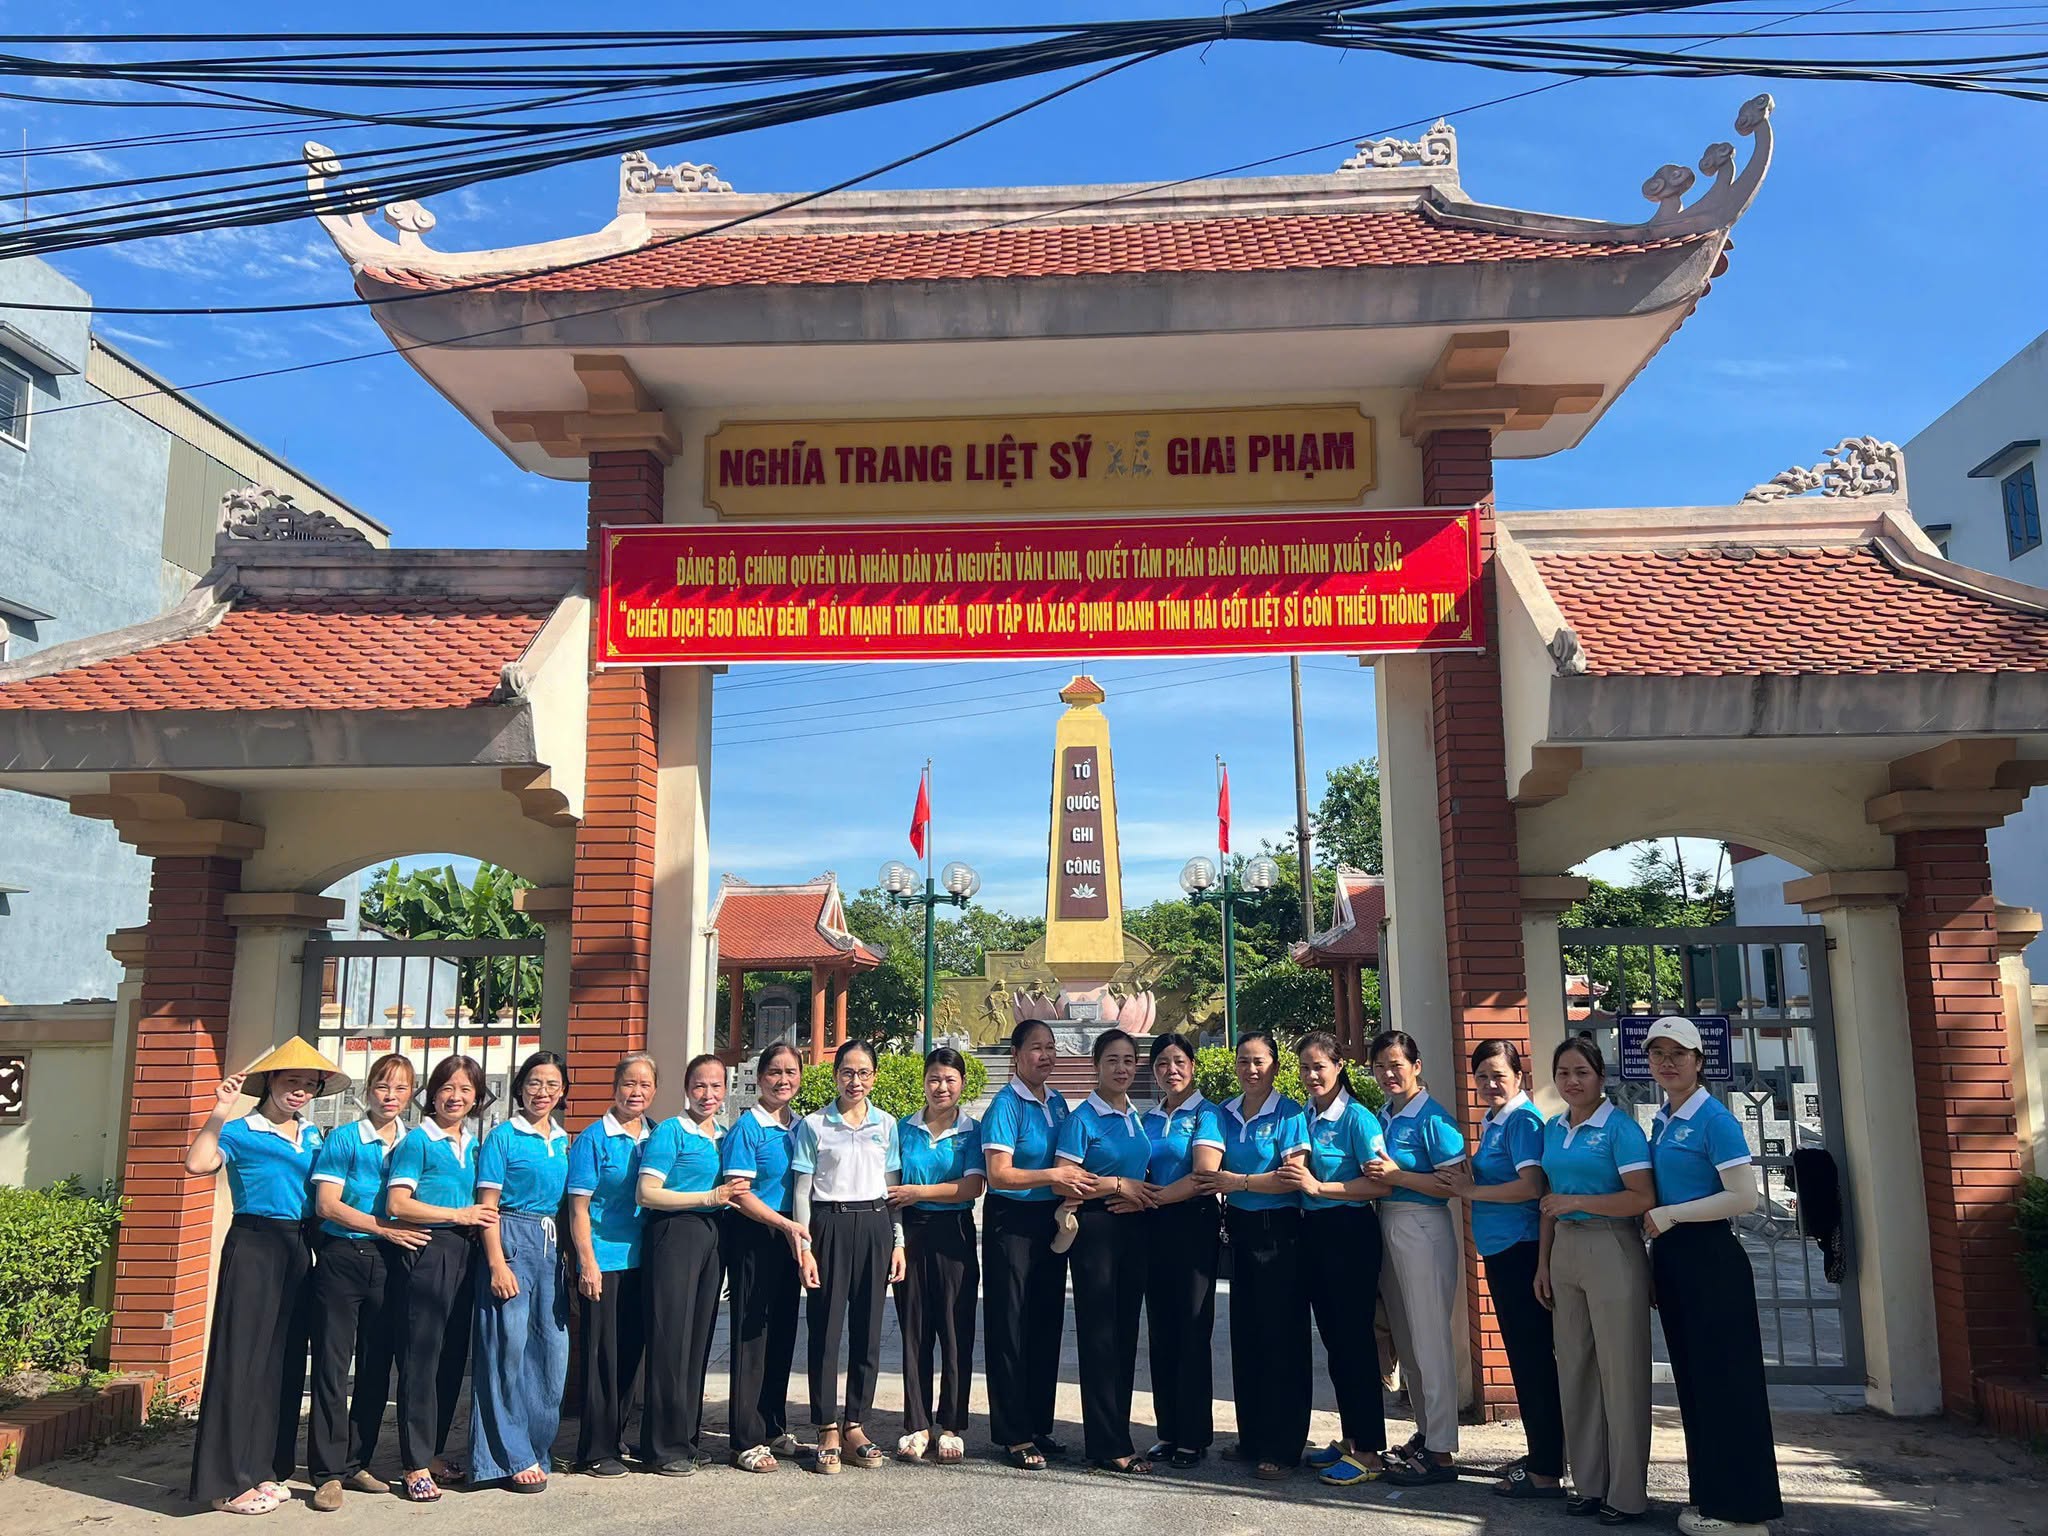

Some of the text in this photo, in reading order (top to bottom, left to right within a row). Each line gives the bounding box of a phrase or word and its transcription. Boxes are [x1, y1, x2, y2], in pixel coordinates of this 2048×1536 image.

[720, 440, 825, 486] NGHĨA
[835, 444, 952, 483] TRANG
[966, 433, 1038, 488] LIỆT
[1049, 433, 1092, 480] SỸ
[1167, 436, 1236, 475] GIAI
[1248, 431, 1355, 479] PHẠM
[676, 530, 1403, 591] ĐẢNG BỘ, CHÍNH QUYỀN VÀ NHÂN DÂN XÃ NGUYỄN VĂN LINH, QUYẾT TÂM PHẤN ĐẤU HOÀN THÀNH XUẤT SẮC
[671, 607, 704, 644] DỊCH
[707, 607, 733, 637] 500
[736, 601, 774, 637] NGÀY
[819, 594, 846, 636] ĐẨY
[850, 605, 891, 642] MẠNH
[895, 599, 920, 635] TÌM
[923, 595, 963, 639] KIẾM,
[966, 604, 993, 638] QUY
[996, 597, 1022, 640] TẬP
[1026, 596, 1044, 633] VÀ
[1047, 596, 1076, 633] XÁC
[1079, 601, 1113, 639] ĐỊNH
[1116, 600, 1154, 632] DANH
[1158, 593, 1190, 631] TÍNH
[1194, 592, 1217, 630] HÀI
[1221, 587, 1248, 629] CỐT
[1251, 591, 1280, 634] LIỆT
[1284, 591, 1299, 629] SĨ
[1302, 588, 1332, 627] CÒN
[1335, 585, 1376, 626] THIẾU
[1380, 587, 1428, 625] THÔNG
[1431, 592, 1460, 624] TIN.
[1073, 758, 1092, 778] TỔ
[1066, 790, 1100, 811] QUỐC
[1072, 827, 1094, 842] GHI
[1065, 856, 1101, 875] CÔNG
[1625, 1027, 1648, 1036] TRUNG
